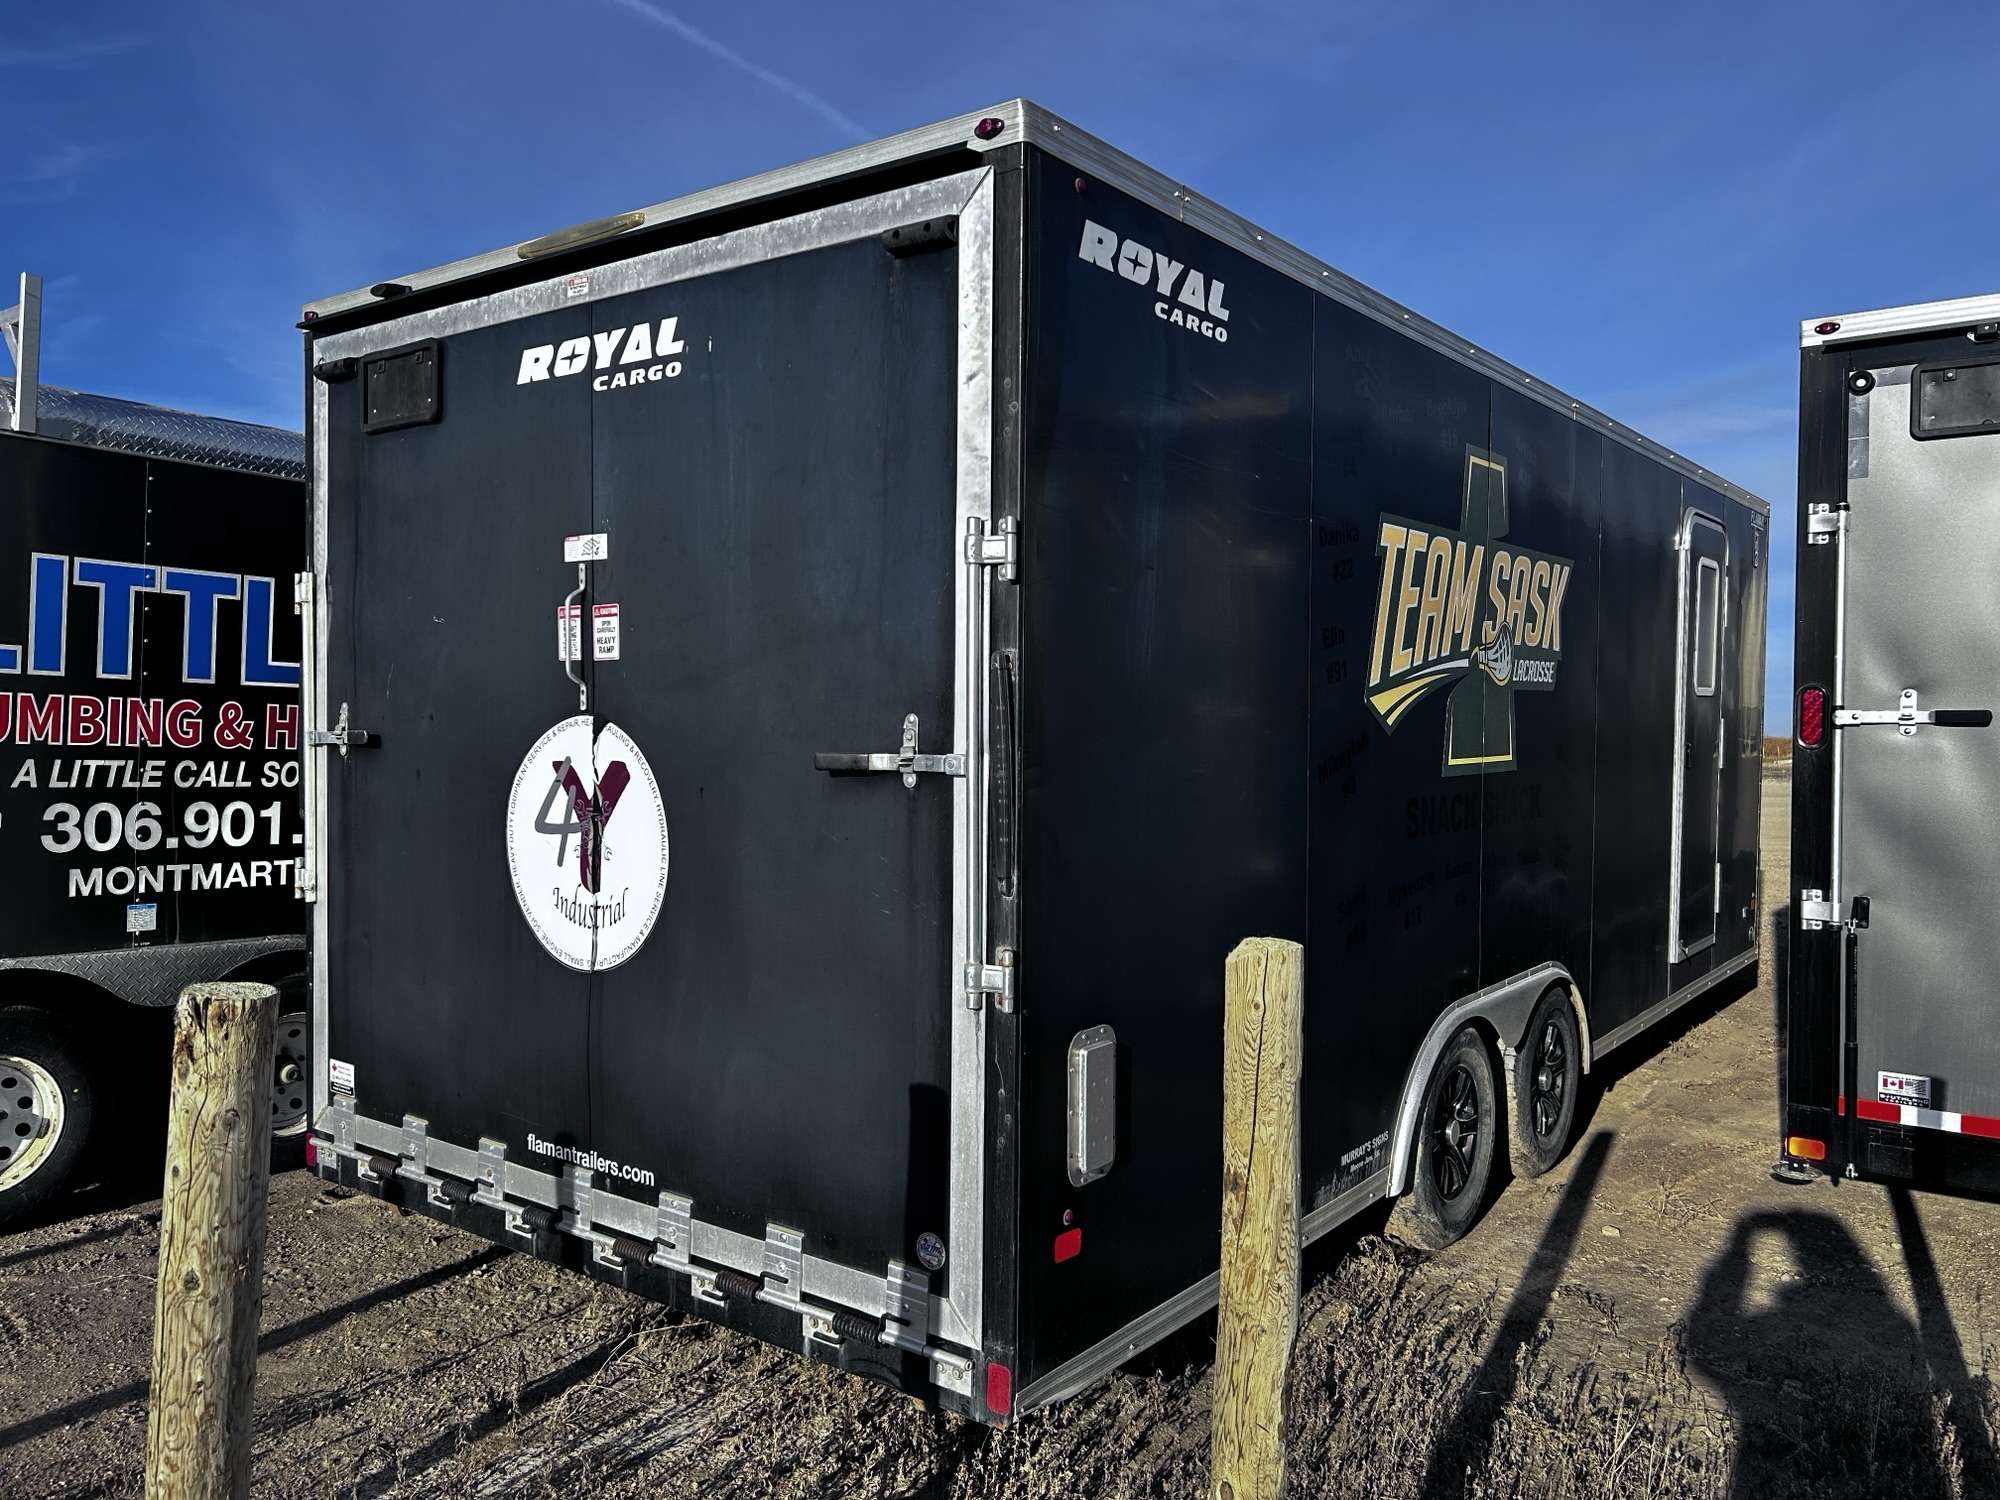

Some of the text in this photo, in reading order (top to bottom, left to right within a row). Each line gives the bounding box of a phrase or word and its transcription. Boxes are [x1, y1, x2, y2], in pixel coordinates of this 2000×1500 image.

[1079, 219, 1229, 321] ROYAL
[1154, 301, 1228, 342] CARGO
[516, 316, 684, 385] ROYAL
[593, 361, 682, 391] CARGO
[0, 552, 300, 687] ITTL
[1369, 522, 1570, 687] TEAM SASK
[1512, 659, 1555, 682] LACROSSE
[214, 701, 254, 750] &
[527, 734, 552, 764] SERVICE
[11, 759, 37, 788] A
[48, 759, 166, 788] LITTLE
[174, 760, 252, 788] CALL
[1408, 791, 1479, 839] SNACK
[68, 859, 294, 897] MONTMART
[553, 883, 629, 929] Industrial
[527, 1132, 655, 1187] flamantrailers.com
[1341, 1141, 1371, 1166] MURRAY'S
